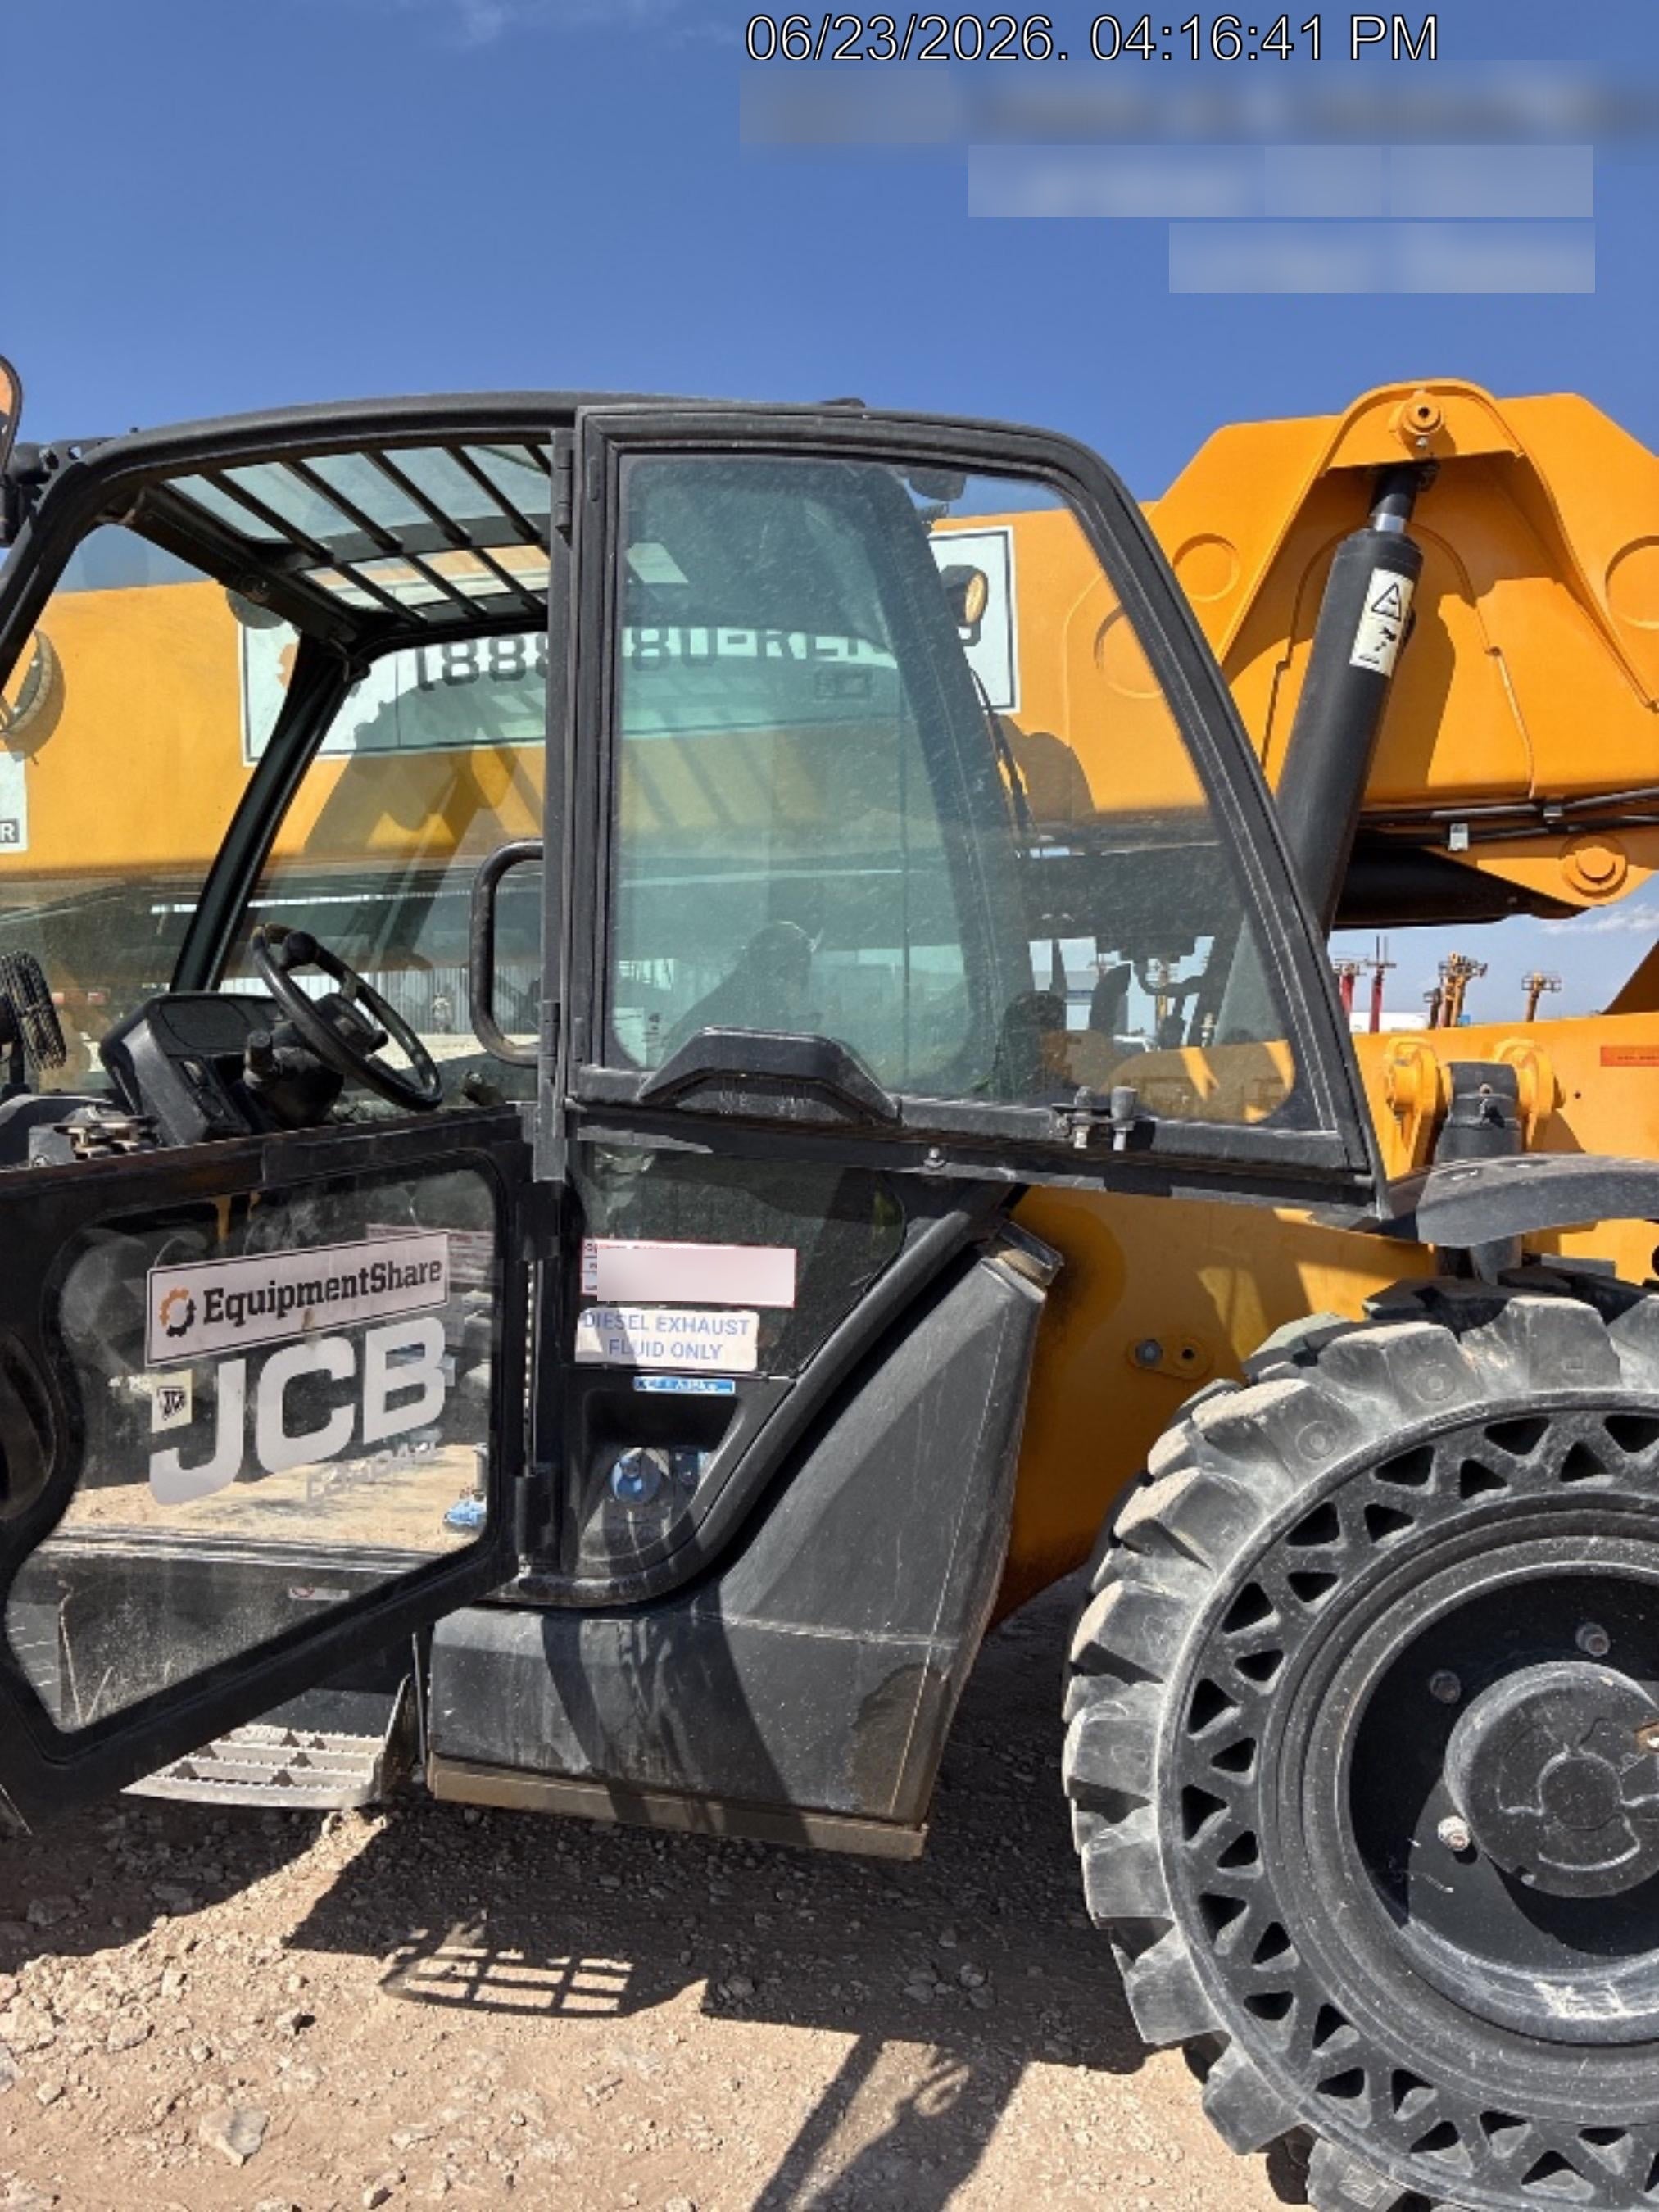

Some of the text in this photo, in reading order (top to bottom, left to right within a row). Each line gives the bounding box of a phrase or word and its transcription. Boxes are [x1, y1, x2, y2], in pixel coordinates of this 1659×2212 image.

[203, 1260, 442, 1327] EquipmentShare
[583, 1312, 750, 1335] DIESEL EXHAUST
[609, 1339, 723, 1360] FLUID ONLY
[149, 1317, 446, 1506] JCB
